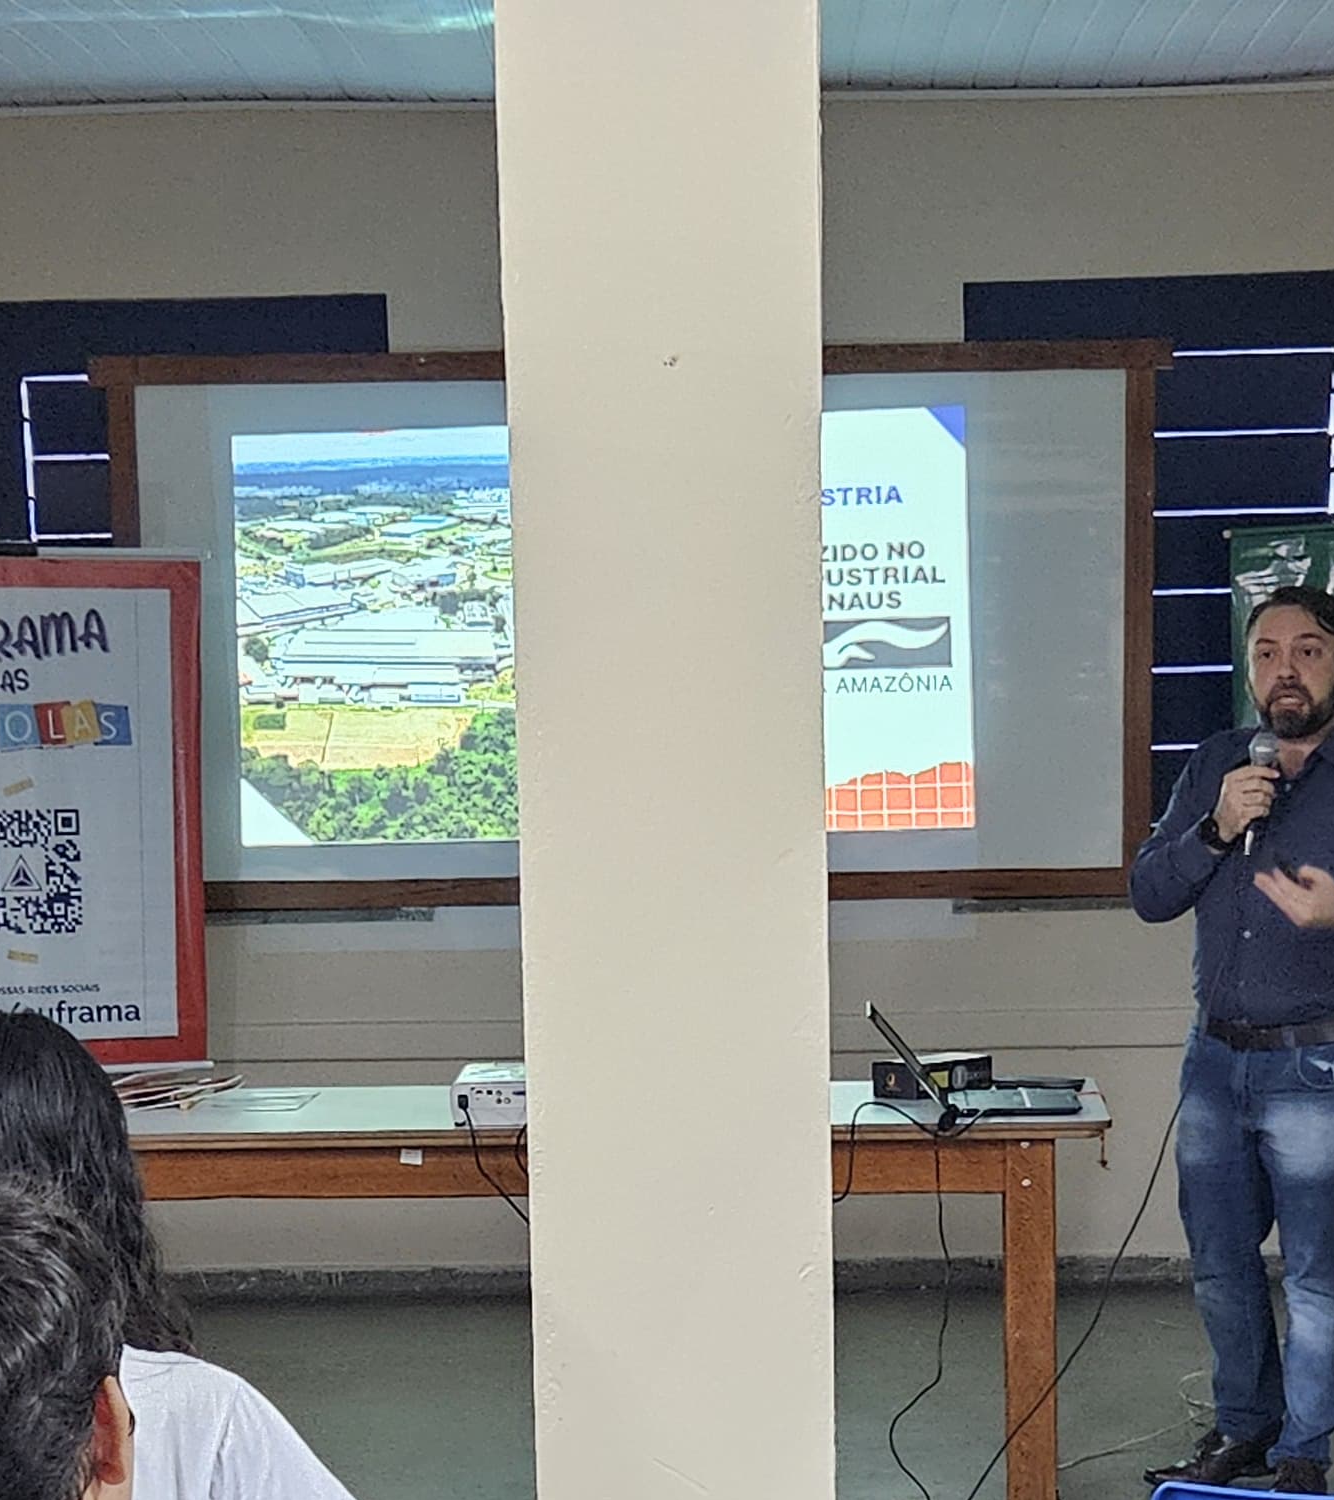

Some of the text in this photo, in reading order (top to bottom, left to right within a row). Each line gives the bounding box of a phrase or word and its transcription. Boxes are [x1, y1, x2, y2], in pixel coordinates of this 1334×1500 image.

[821, 485, 903, 506] STRIA
[820, 541, 925, 562] ZIDO NO
[825, 565, 946, 587] USTRIAL
[822, 591, 902, 611] NAUS
[835, 672, 953, 694] AMAZÔNIA
